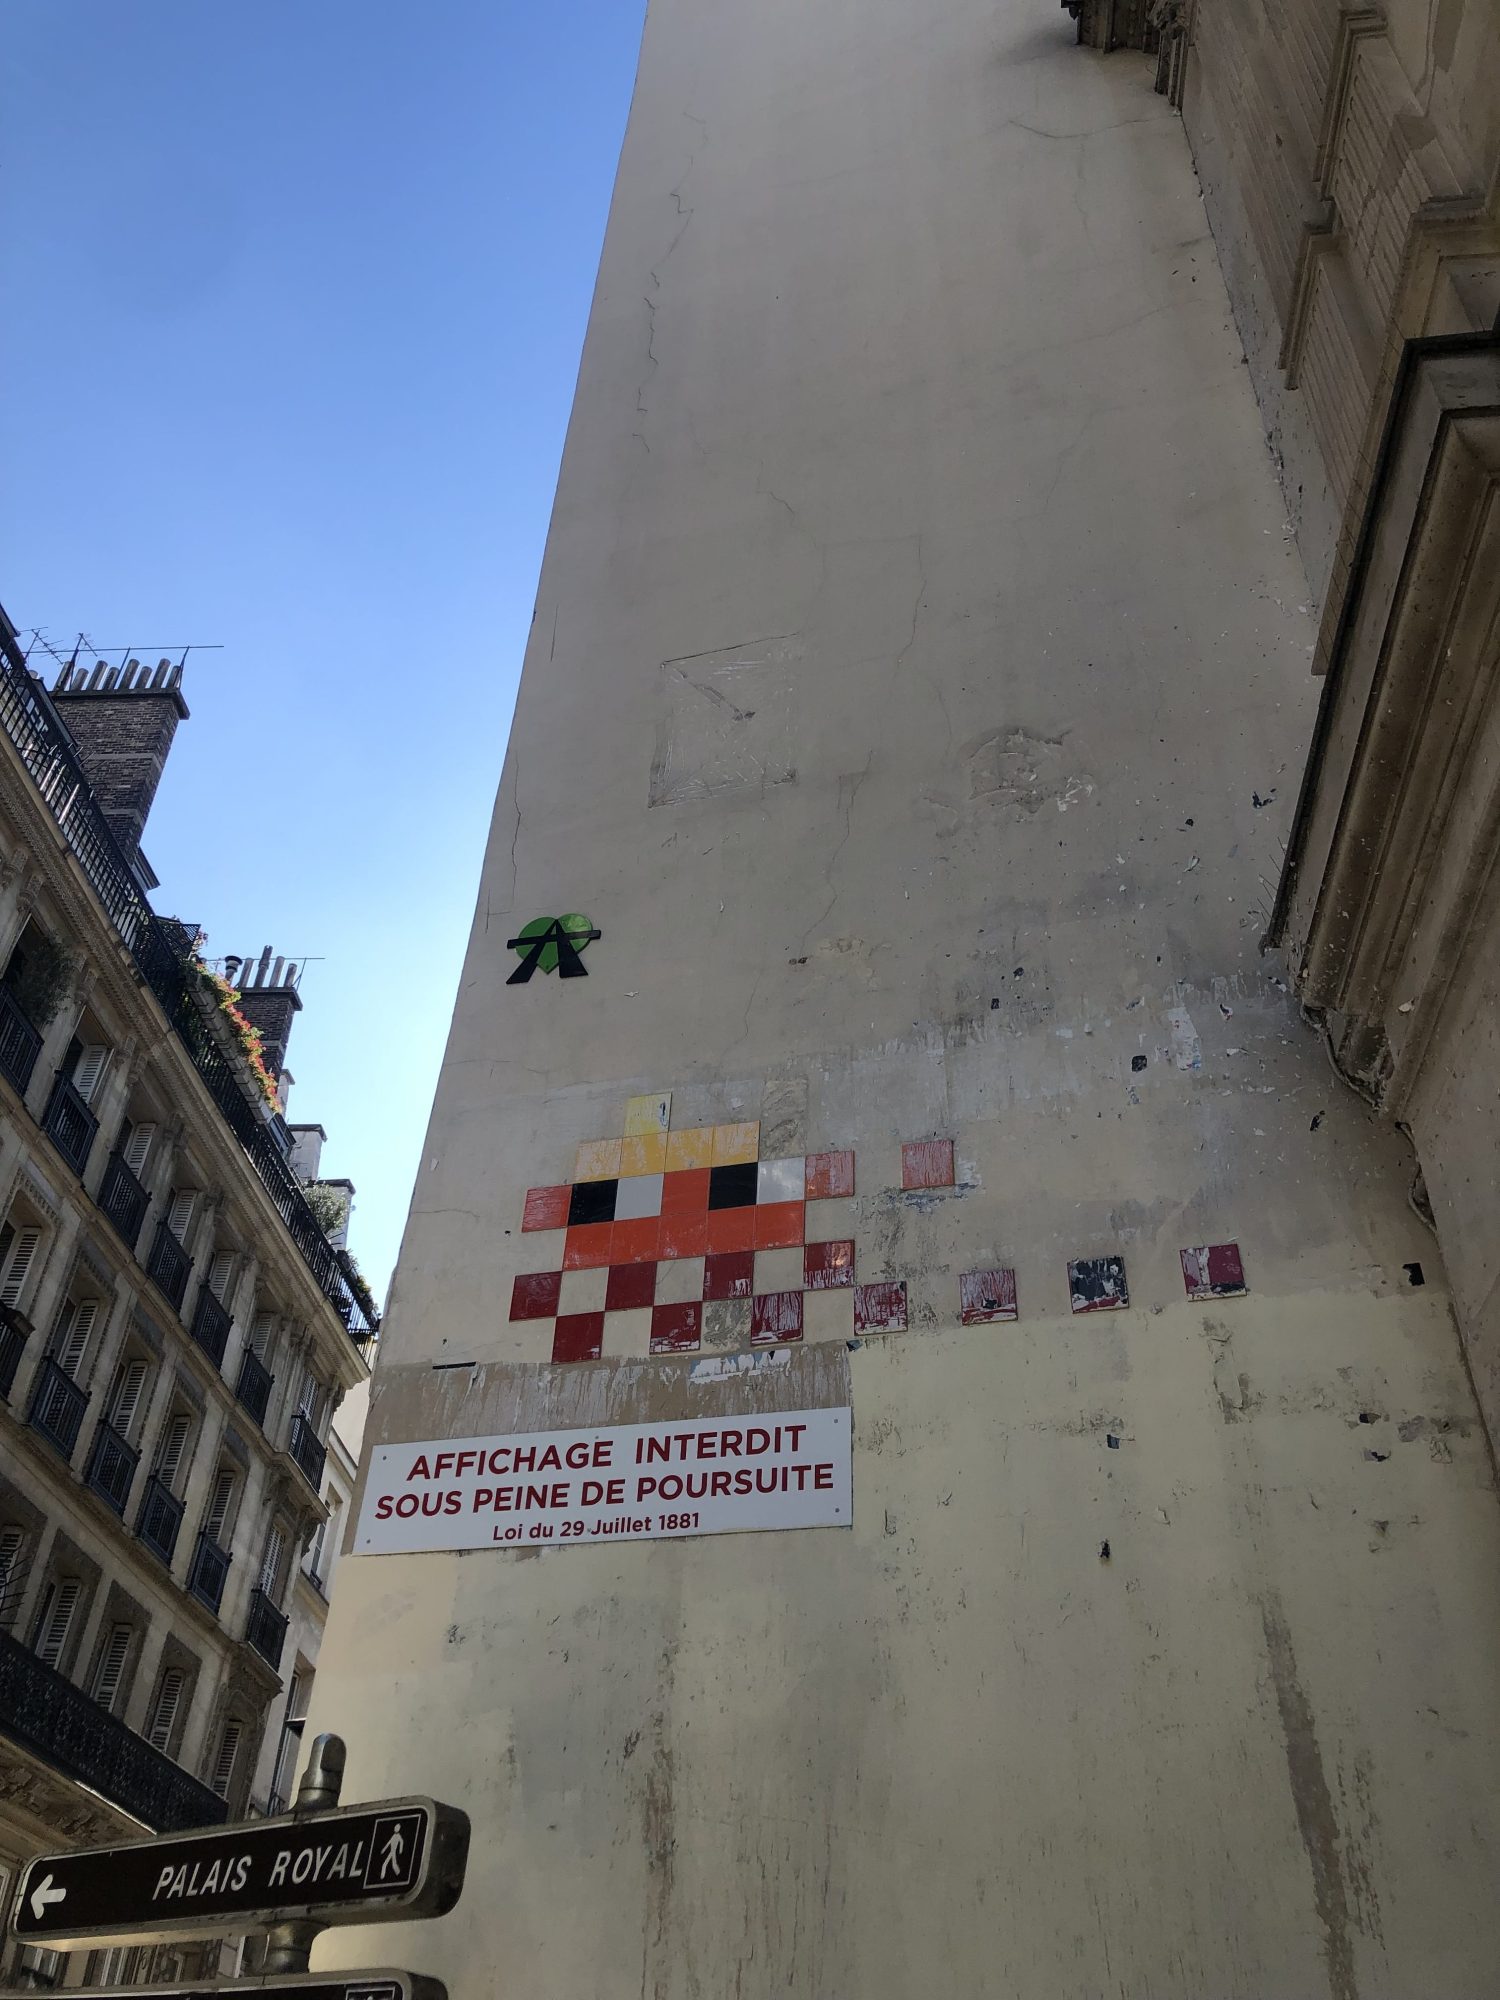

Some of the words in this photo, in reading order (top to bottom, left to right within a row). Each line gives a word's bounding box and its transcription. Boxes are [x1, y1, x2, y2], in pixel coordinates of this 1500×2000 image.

[407, 1440, 614, 1481] AFFICHAGE
[635, 1424, 807, 1464] INTERDIT
[374, 1490, 462, 1520] SOUS
[472, 1482, 570, 1513] PEINE
[581, 1478, 626, 1506] DE
[636, 1463, 834, 1502] POURSUITE
[492, 1524, 523, 1541] Loi
[528, 1522, 554, 1539] du
[561, 1520, 585, 1537] 29
[590, 1516, 652, 1536] Juillet
[659, 1512, 700, 1531] 1881
[152, 1855, 252, 1900] PALAIS
[268, 1839, 365, 1888] ROYAL
